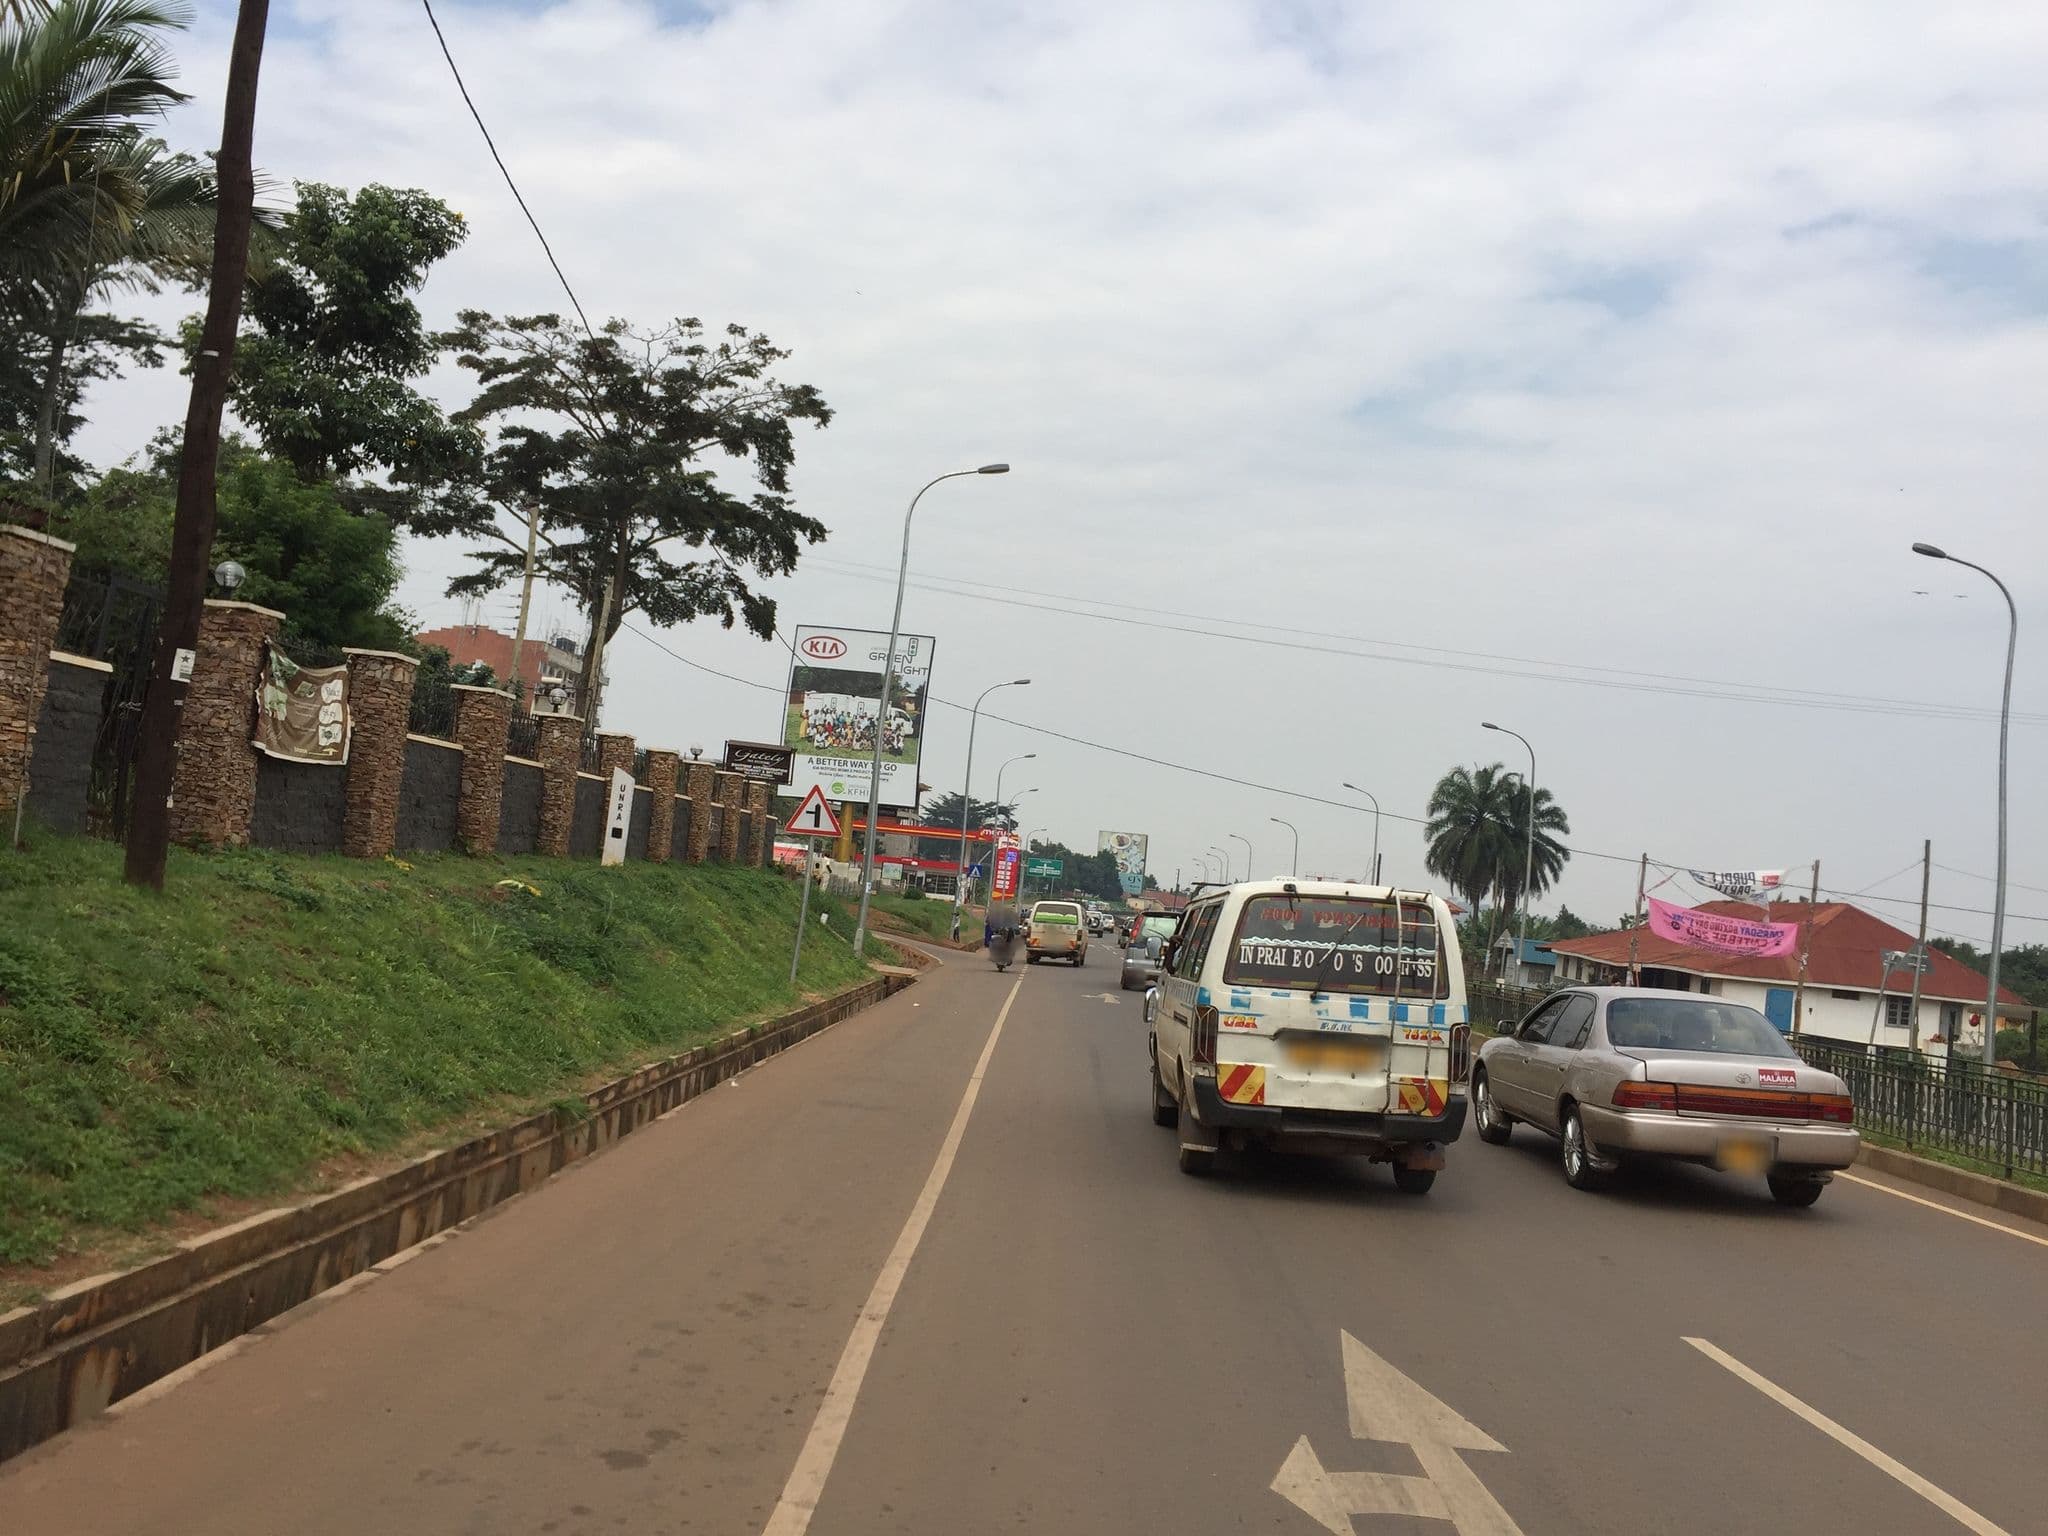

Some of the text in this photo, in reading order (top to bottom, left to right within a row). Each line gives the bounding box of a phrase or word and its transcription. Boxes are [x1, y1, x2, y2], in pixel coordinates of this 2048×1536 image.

[809, 641, 839, 655] KIA
[869, 652, 913, 664] GREN
[808, 757, 814, 765] A
[816, 757, 848, 768] BETTER
[850, 761, 869, 769] WAY
[884, 764, 897, 772] GO
[616, 784, 626, 820] UNRA
[1240, 945, 1254, 965] IN
[1256, 946, 1302, 968] PRAIE
[1760, 1074, 1796, 1083] MALAIKA
